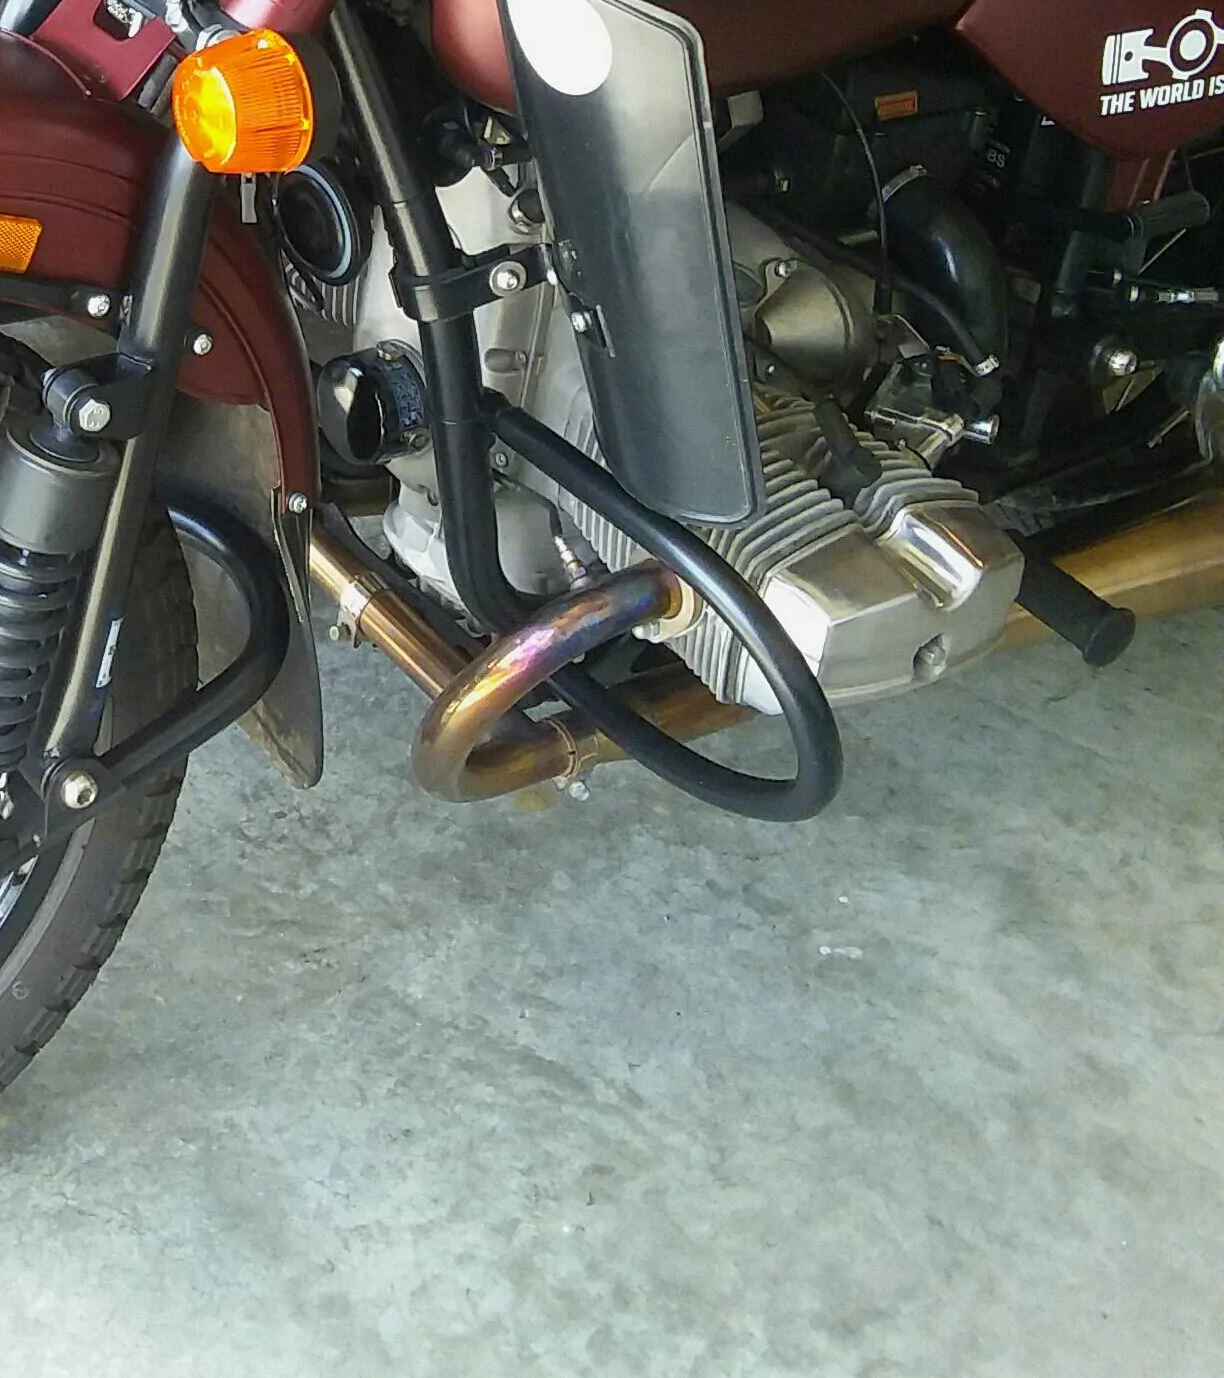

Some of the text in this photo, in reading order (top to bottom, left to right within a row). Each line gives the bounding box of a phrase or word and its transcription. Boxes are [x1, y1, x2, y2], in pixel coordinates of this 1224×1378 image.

[1100, 74, 1224, 116] THE WORLD IS
